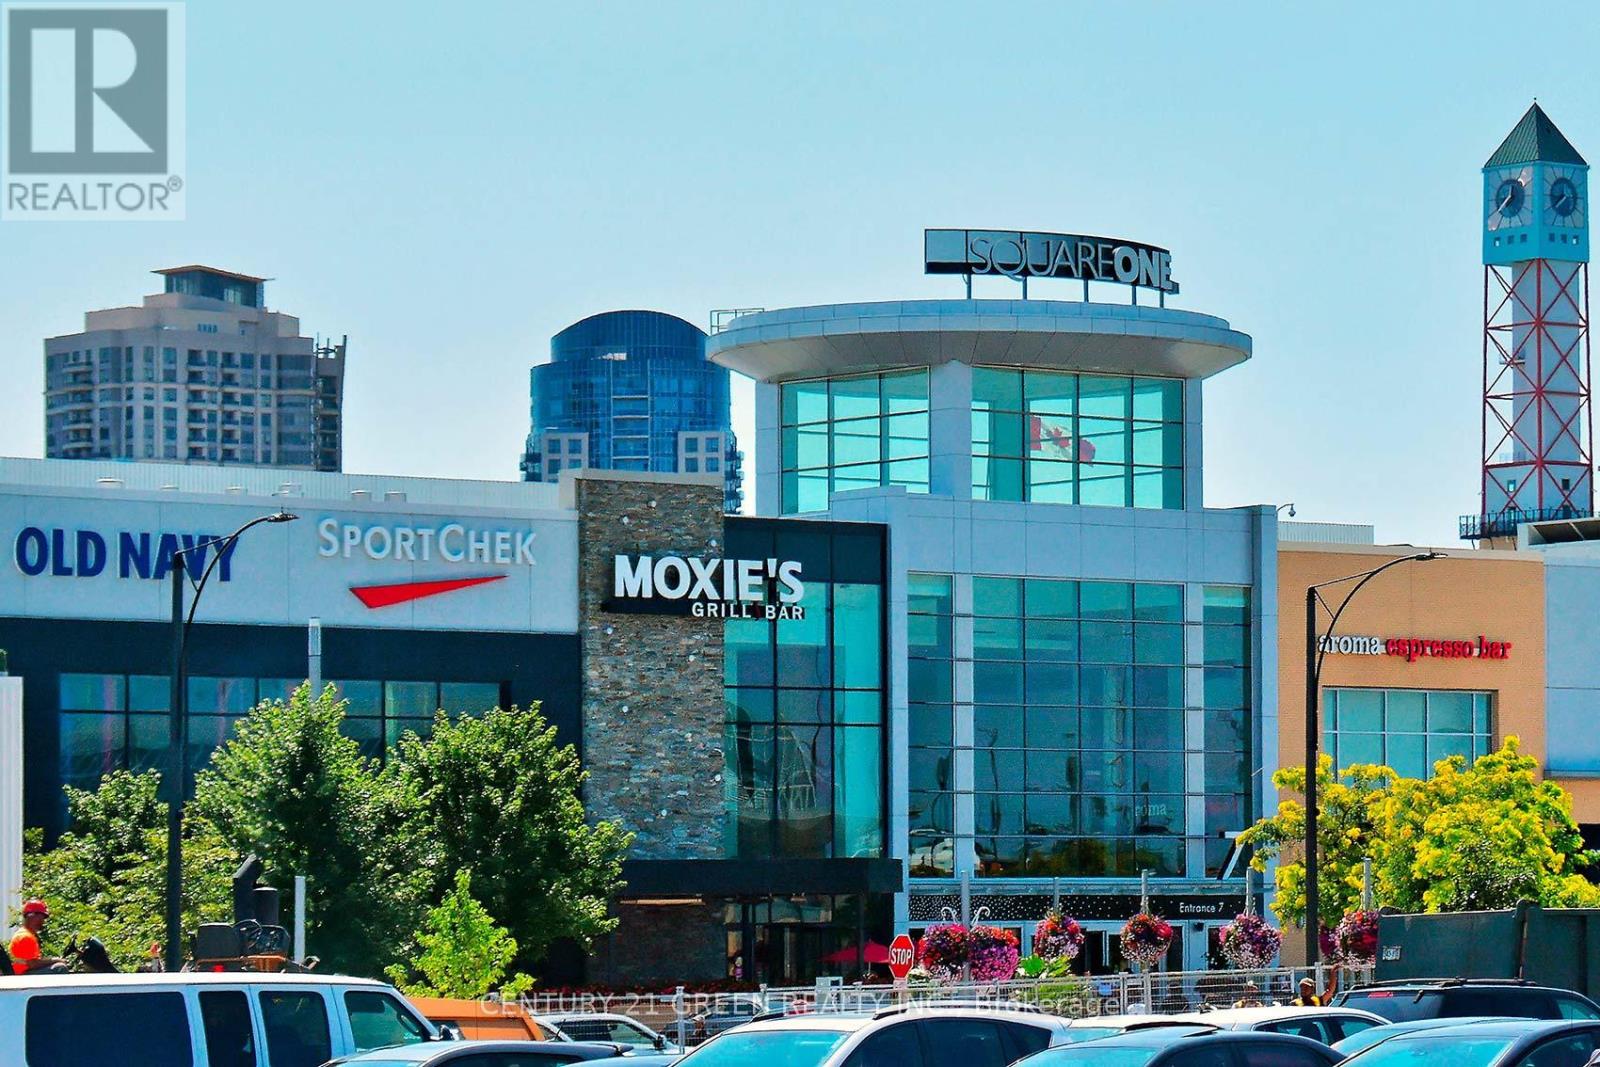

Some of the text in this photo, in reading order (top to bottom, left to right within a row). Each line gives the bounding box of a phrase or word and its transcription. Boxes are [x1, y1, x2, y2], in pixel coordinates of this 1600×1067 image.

[15, 526, 239, 582] OLD NAVY
[614, 554, 805, 603] MOXIE'S
[691, 602, 804, 620] GRILL BAR
[1318, 634, 1513, 663] aroma espresso bar
[1179, 902, 1224, 913] Entrance 7
[890, 948, 912, 965] STOP
